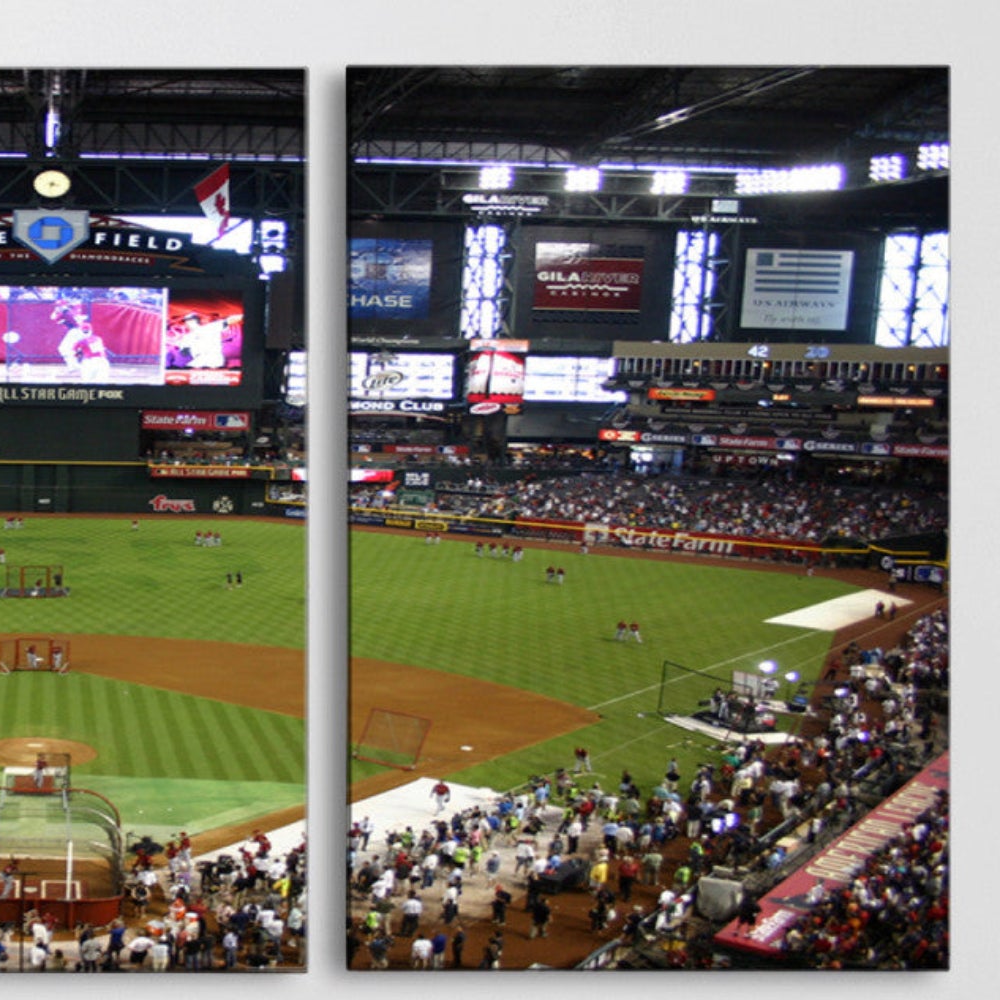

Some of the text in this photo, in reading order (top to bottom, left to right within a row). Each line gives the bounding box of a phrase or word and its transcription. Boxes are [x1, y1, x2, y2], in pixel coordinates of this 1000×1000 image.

[462, 194, 499, 204] GILA
[94, 232, 183, 251] FIELD
[537, 271, 580, 282] GILA
[348, 294, 413, 308] HASE
[748, 345, 770, 358] 42
[20, 387, 56, 400] STAR
[58, 389, 96, 403] GAME
[98, 389, 124, 399] FOX
[144, 414, 174, 424] State
